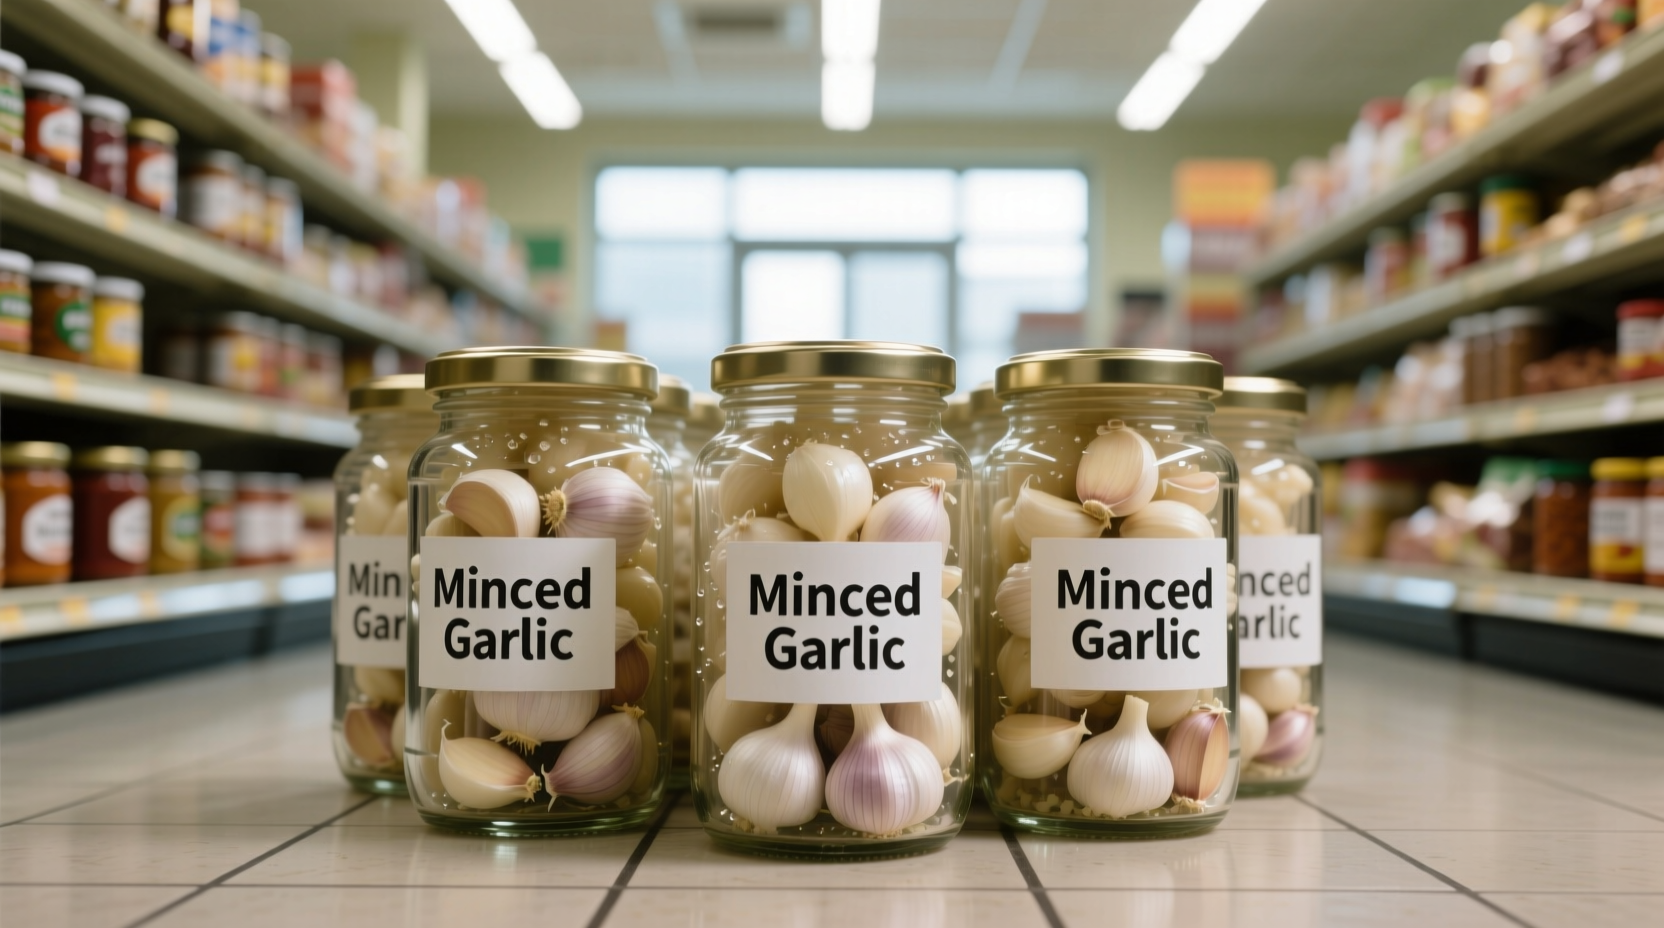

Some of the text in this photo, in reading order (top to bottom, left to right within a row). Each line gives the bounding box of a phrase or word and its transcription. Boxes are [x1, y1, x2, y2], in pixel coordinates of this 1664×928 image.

[348, 561, 401, 597] Min
[434, 565, 591, 610] Minced
[749, 570, 921, 618] Minced
[1057, 566, 1213, 611] Minced
[1239, 562, 1311, 597] nced
[353, 605, 406, 640] Gar
[444, 616, 574, 661] Garlic
[1071, 617, 1201, 661] Garlic
[1239, 605, 1301, 639] arlic
[764, 624, 905, 671] Garlic
